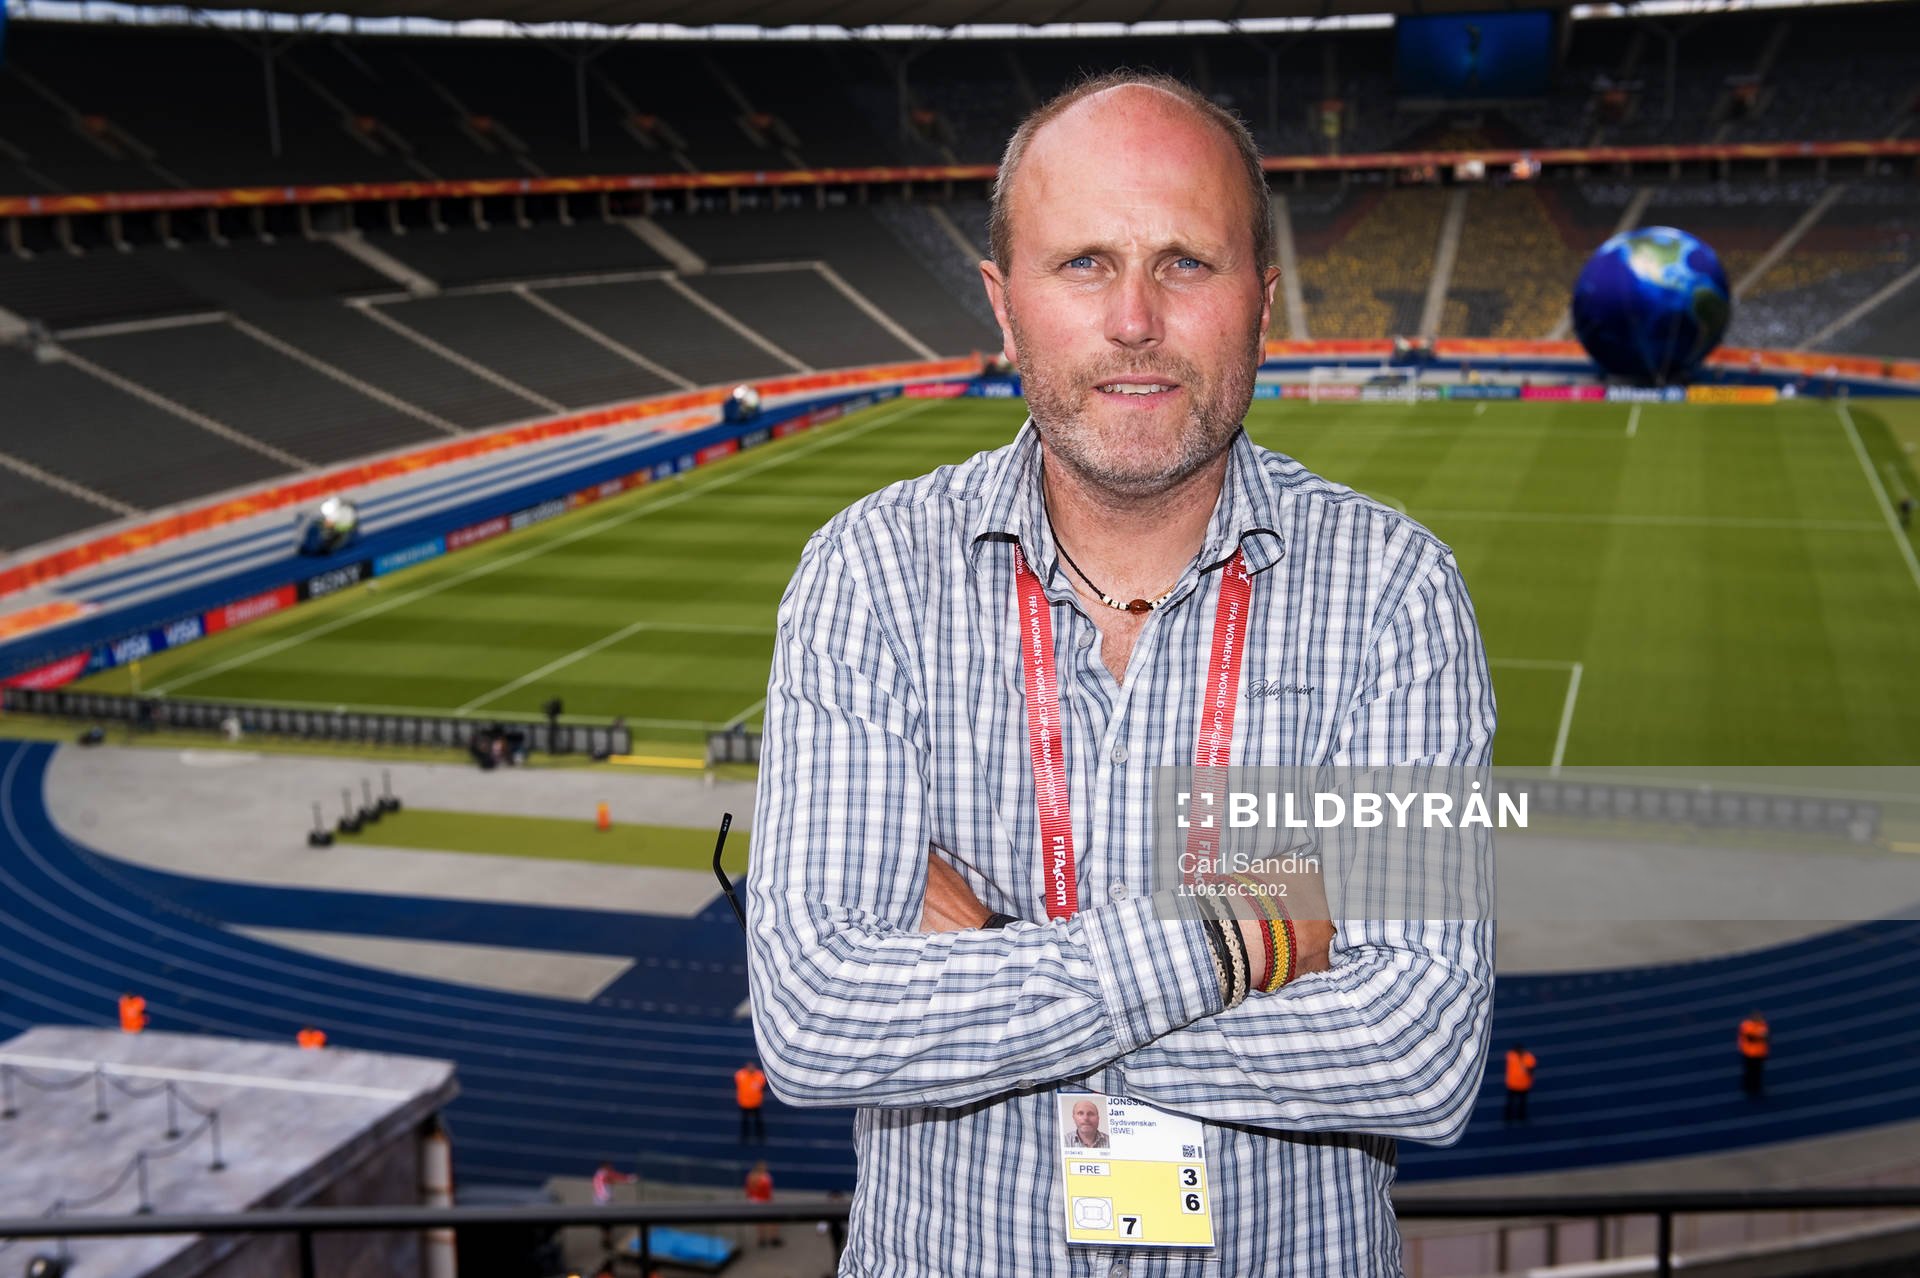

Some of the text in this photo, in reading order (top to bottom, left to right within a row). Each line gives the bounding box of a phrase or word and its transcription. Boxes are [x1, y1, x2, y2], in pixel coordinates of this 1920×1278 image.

[1028, 596, 1038, 616] FIFA
[1228, 601, 1238, 621] FIFA
[1030, 617, 1043, 665] WOMEN'S
[1221, 623, 1236, 670] WOMEN'S
[1035, 667, 1047, 705] WORLD
[1216, 672, 1229, 708] WORLD
[1039, 707, 1049, 727] CUP
[1213, 710, 1224, 730] CUP
[1108, 1108, 1125, 1117] Jan
[1109, 1118, 1157, 1127] Sydsvenskan
[1110, 1127, 1134, 1136] (SWE)
[1079, 1165, 1101, 1174] PRE
[1183, 1168, 1198, 1186] 3
[1185, 1193, 1200, 1211] 6
[1122, 1217, 1137, 1235] 7
